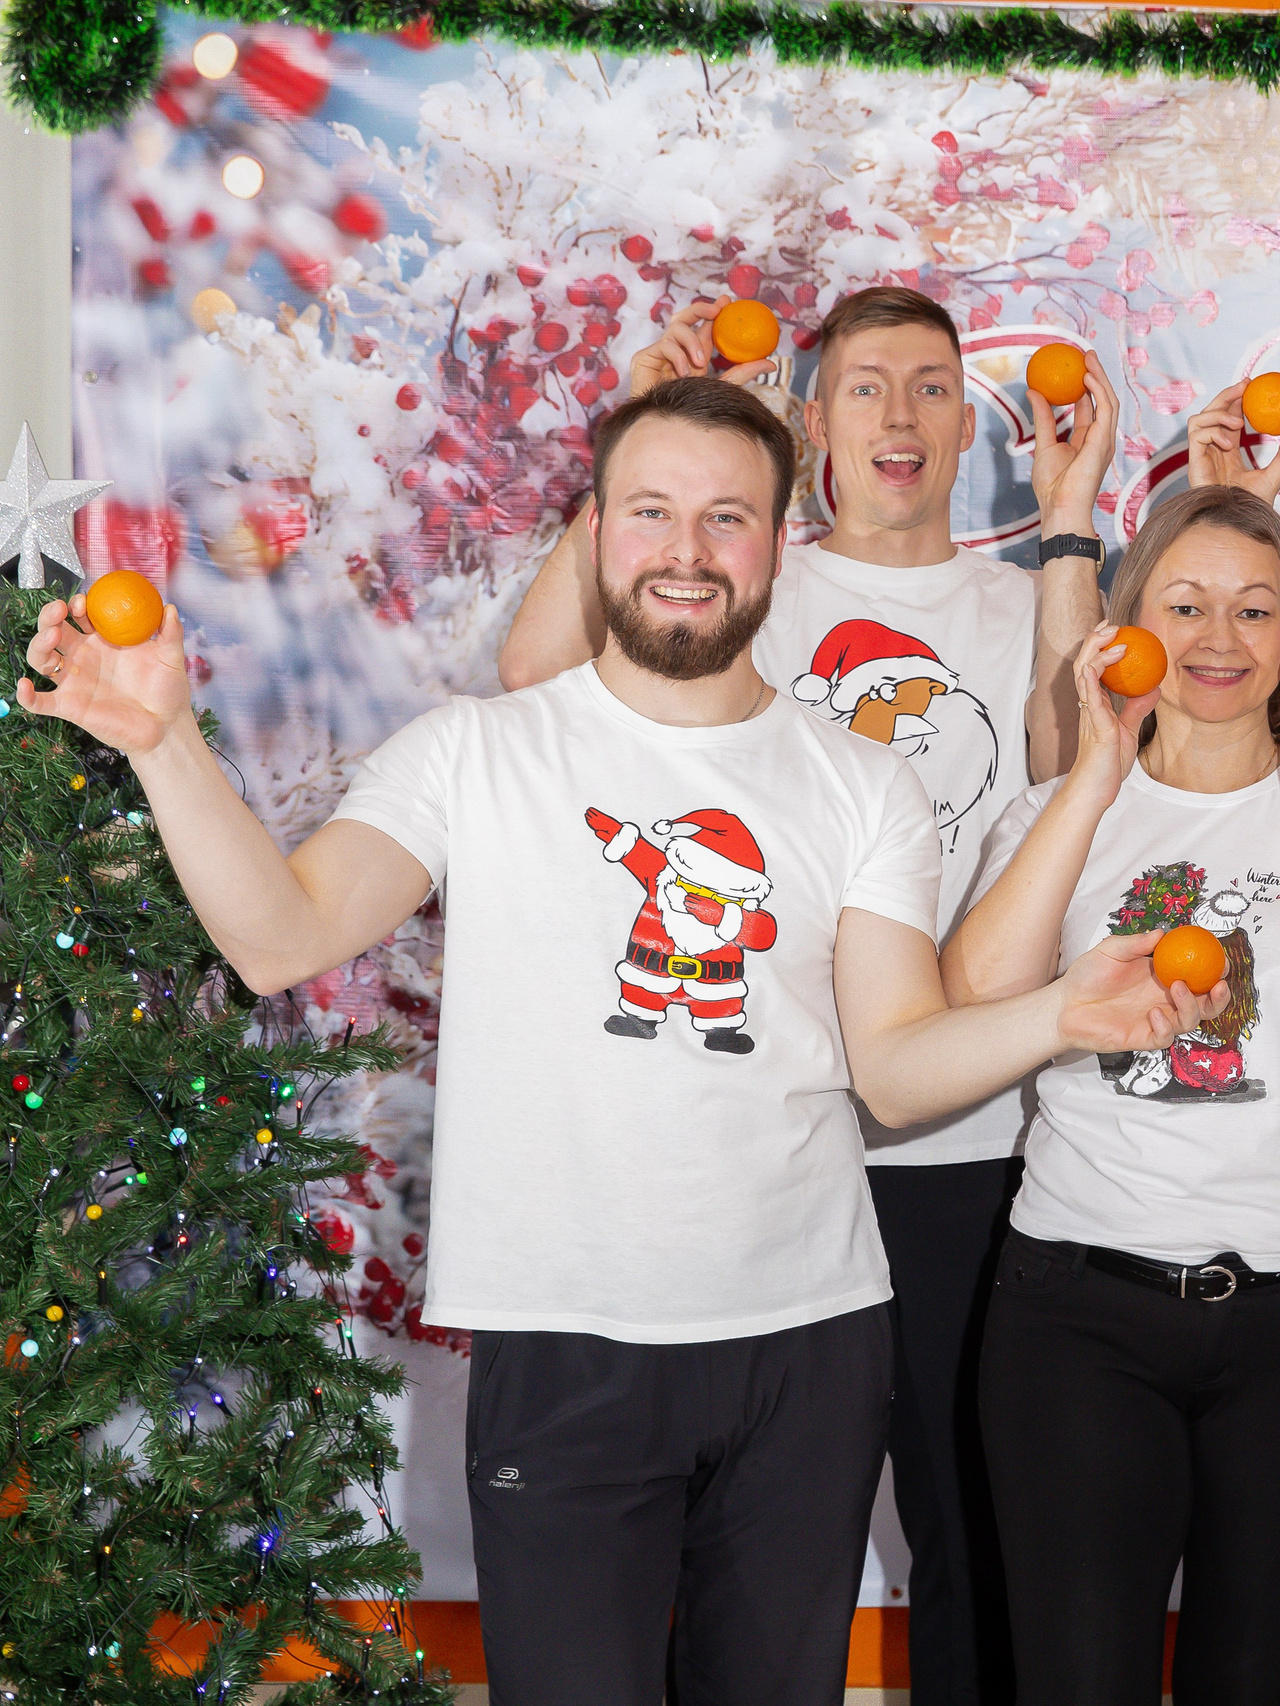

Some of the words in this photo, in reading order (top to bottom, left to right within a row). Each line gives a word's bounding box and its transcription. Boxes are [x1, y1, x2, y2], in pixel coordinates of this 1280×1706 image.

[1246, 867, 1280, 886] Winter
[1259, 885, 1268, 893] is
[1249, 890, 1275, 903] here
